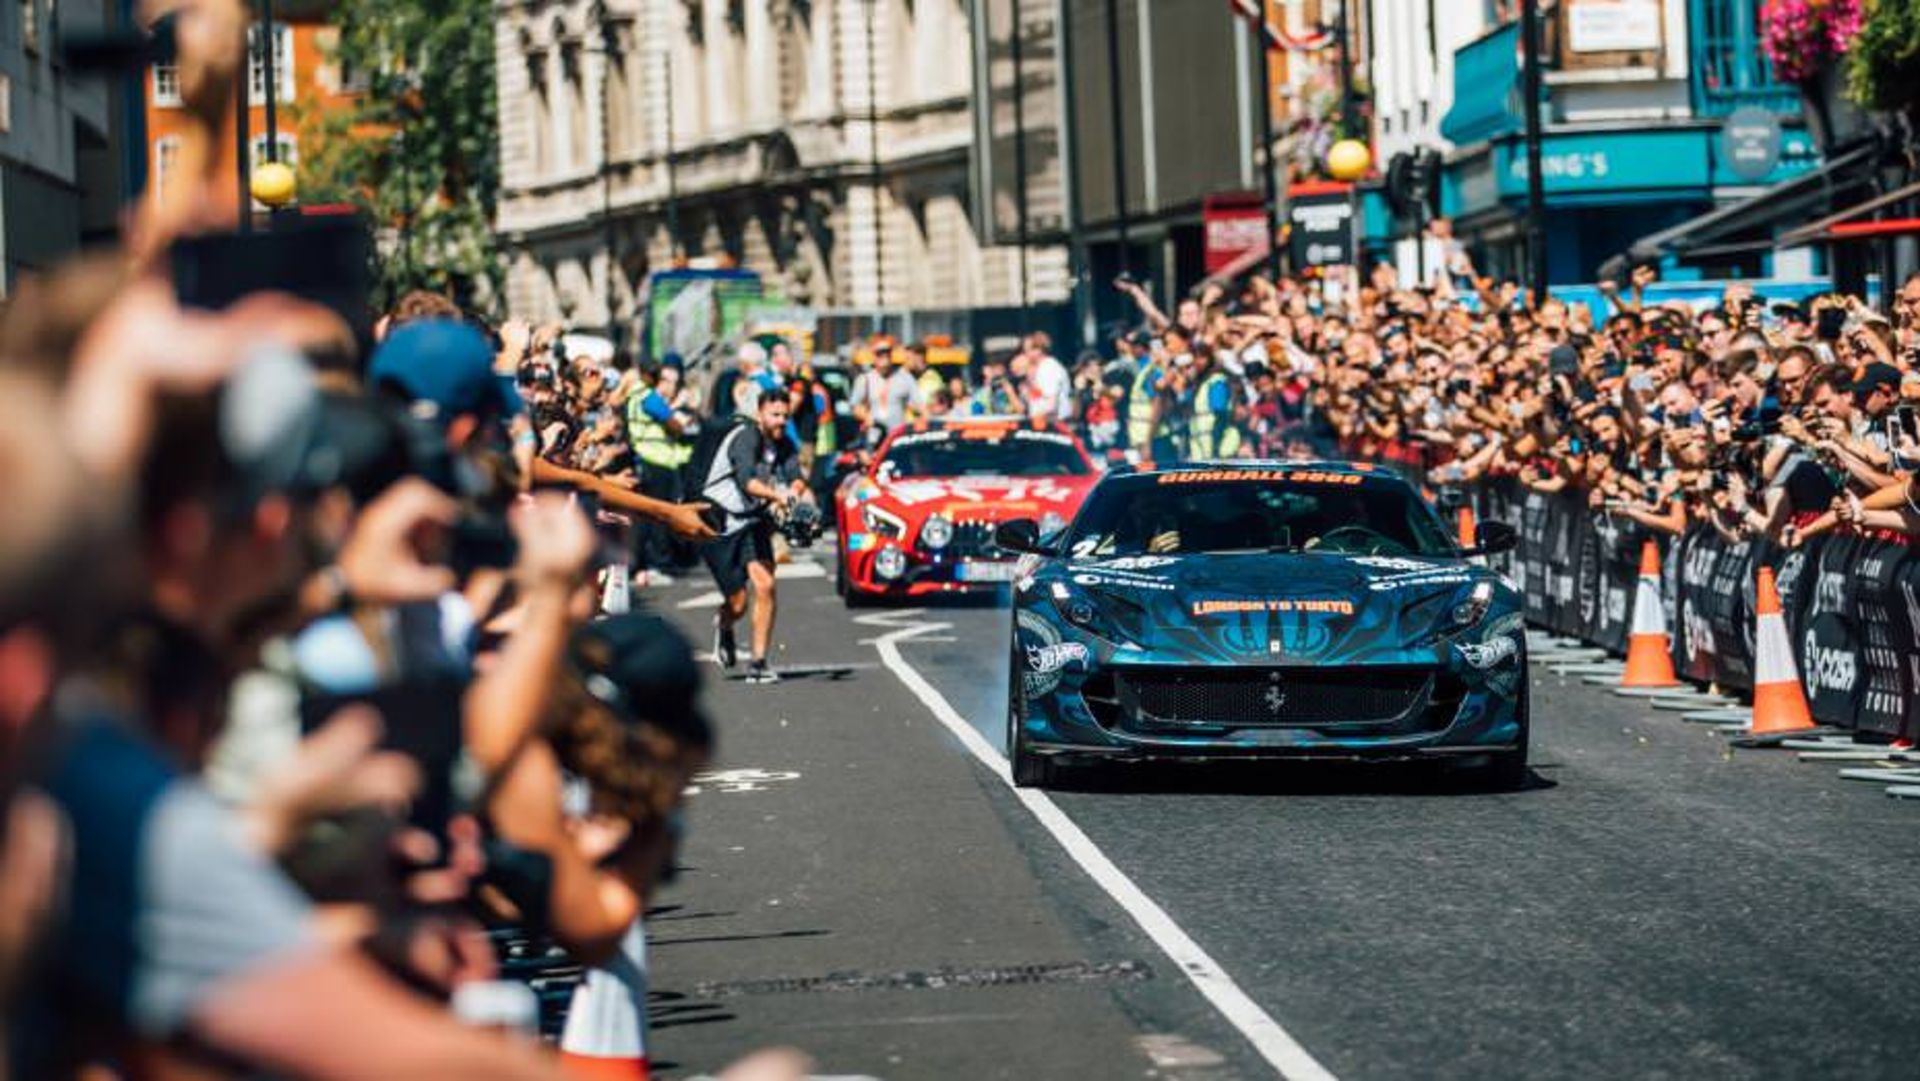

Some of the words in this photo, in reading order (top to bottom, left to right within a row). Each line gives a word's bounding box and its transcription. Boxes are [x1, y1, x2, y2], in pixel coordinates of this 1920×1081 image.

[1157, 470, 1285, 484] GUMBALL
[1289, 471, 1363, 485] 3000
[1193, 600, 1265, 615] LONDON
[1267, 600, 1292, 611] TO
[1294, 600, 1354, 615] TOKYO
